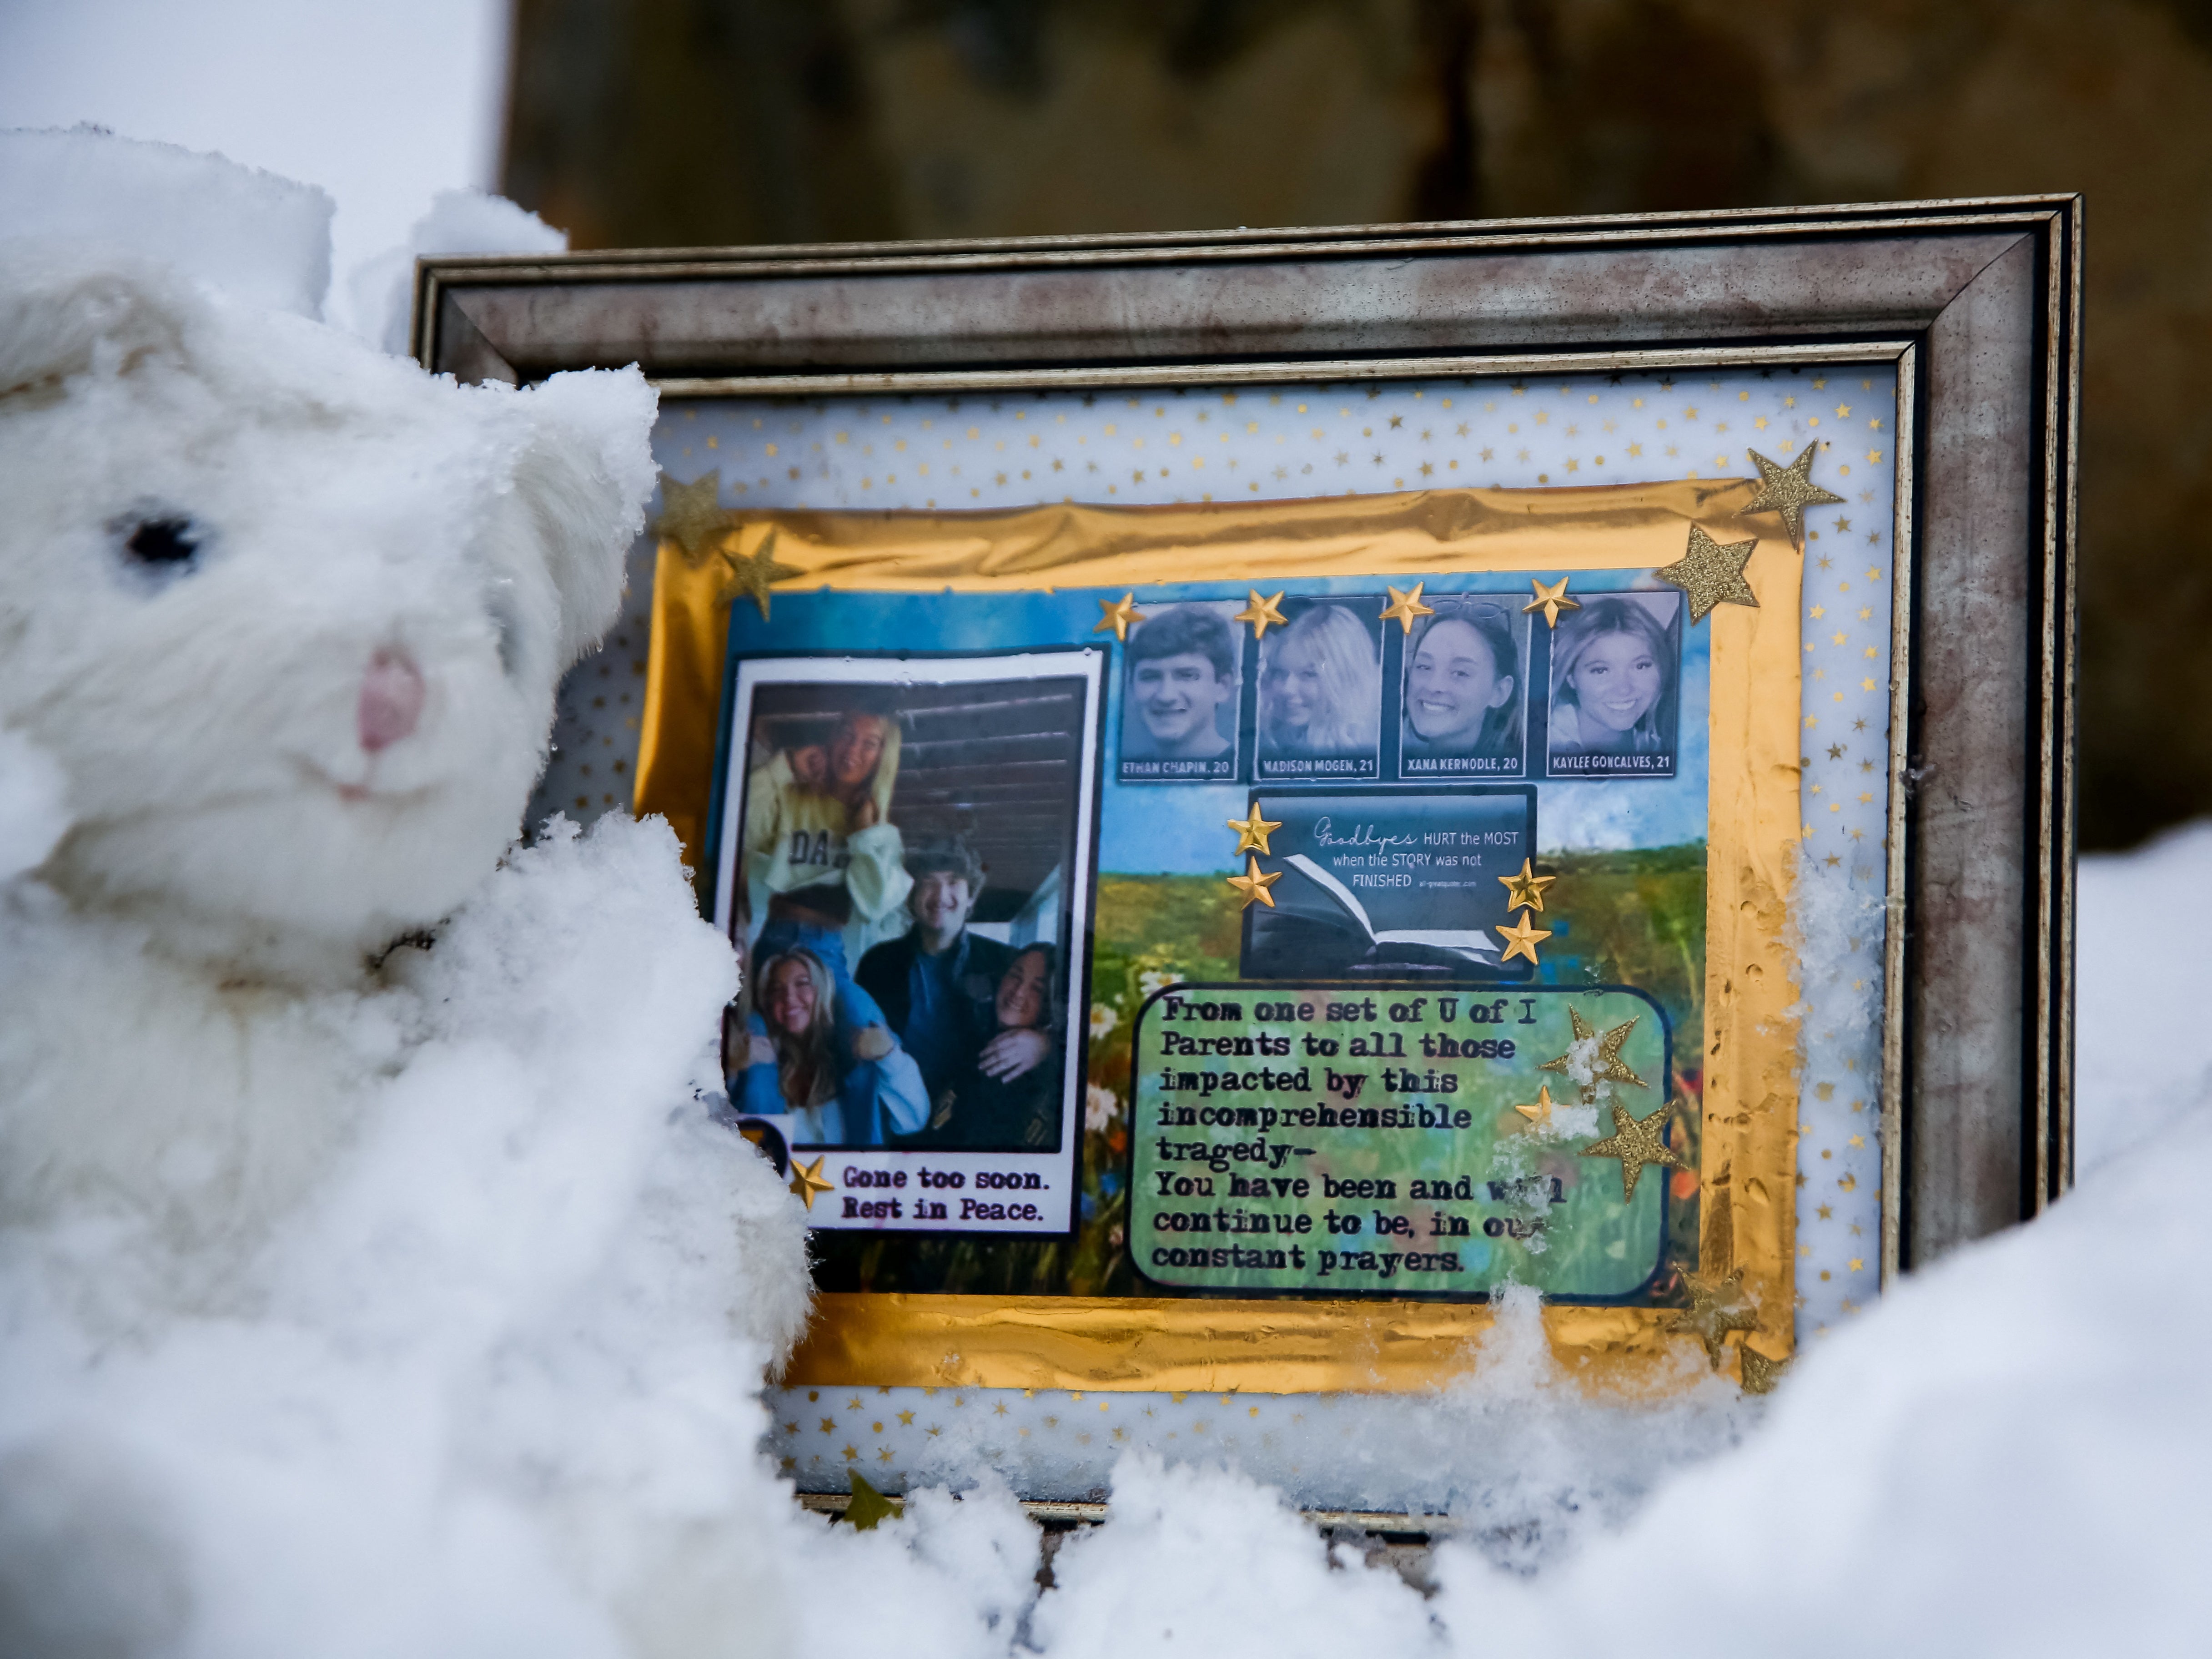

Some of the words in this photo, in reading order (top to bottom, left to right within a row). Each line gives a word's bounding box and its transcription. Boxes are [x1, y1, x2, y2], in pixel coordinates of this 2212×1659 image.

[1122, 761, 1160, 773] ETHAN
[1213, 761, 1229, 772] 20
[1264, 760, 1312, 772] MADISON
[1315, 760, 1356, 773] MOGEN,
[1360, 759, 1373, 771] 21
[1408, 759, 1437, 770] XANA
[1440, 758, 1500, 771] KERNODLE,
[1503, 757, 1518, 769] 20
[1553, 756, 1589, 768] KAYLEE
[1592, 756, 1654, 769] GONCALVES,
[1658, 756, 1670, 767] 21
[1314, 816, 1418, 855] Goodbyes
[1424, 832, 1456, 845] HURT
[1460, 832, 1480, 844] the
[1484, 832, 1519, 844] MOST
[1333, 853, 1364, 866] when
[1368, 853, 1388, 866] the
[1392, 853, 1431, 865] STORY
[1436, 856, 1458, 866] was
[1463, 854, 1482, 866] not
[1352, 874, 1412, 887] FINISHED
[1161, 995, 1243, 1021] From
[1254, 1002, 1315, 1022] one
[1326, 997, 1377, 1021] set
[1388, 998, 1428, 1023] of
[1438, 997, 1459, 1023] U
[1469, 998, 1508, 1024] of
[1518, 998, 1537, 1024] I
[1160, 1030, 1291, 1056] Parents
[1301, 1032, 1340, 1056] to
[1349, 1031, 1407, 1057] all
[1418, 1032, 1516, 1059] those
[1159, 1066, 1312, 1097] impacted
[1324, 1066, 1368, 1099] by
[1381, 1067, 1458, 1093] this
[1157, 1101, 1472, 1132] incomprehensible
[843, 1165, 907, 1188] Gone
[917, 1166, 965, 1189] too
[975, 1171, 1050, 1190] soon.
[1155, 1170, 1216, 1196] You
[1228, 1172, 1310, 1198] have
[1322, 1173, 1397, 1199] been
[1410, 1175, 1473, 1200] and
[841, 1196, 902, 1219] Rest
[913, 1198, 948, 1219] in
[959, 1198, 1044, 1220] Peace.
[1153, 1207, 1312, 1234] continue
[1323, 1209, 1362, 1235] to
[1372, 1209, 1415, 1238] be,
[1429, 1210, 1470, 1236] in
[1151, 1243, 1305, 1269] constant
[1317, 1244, 1464, 1278] prayers.
